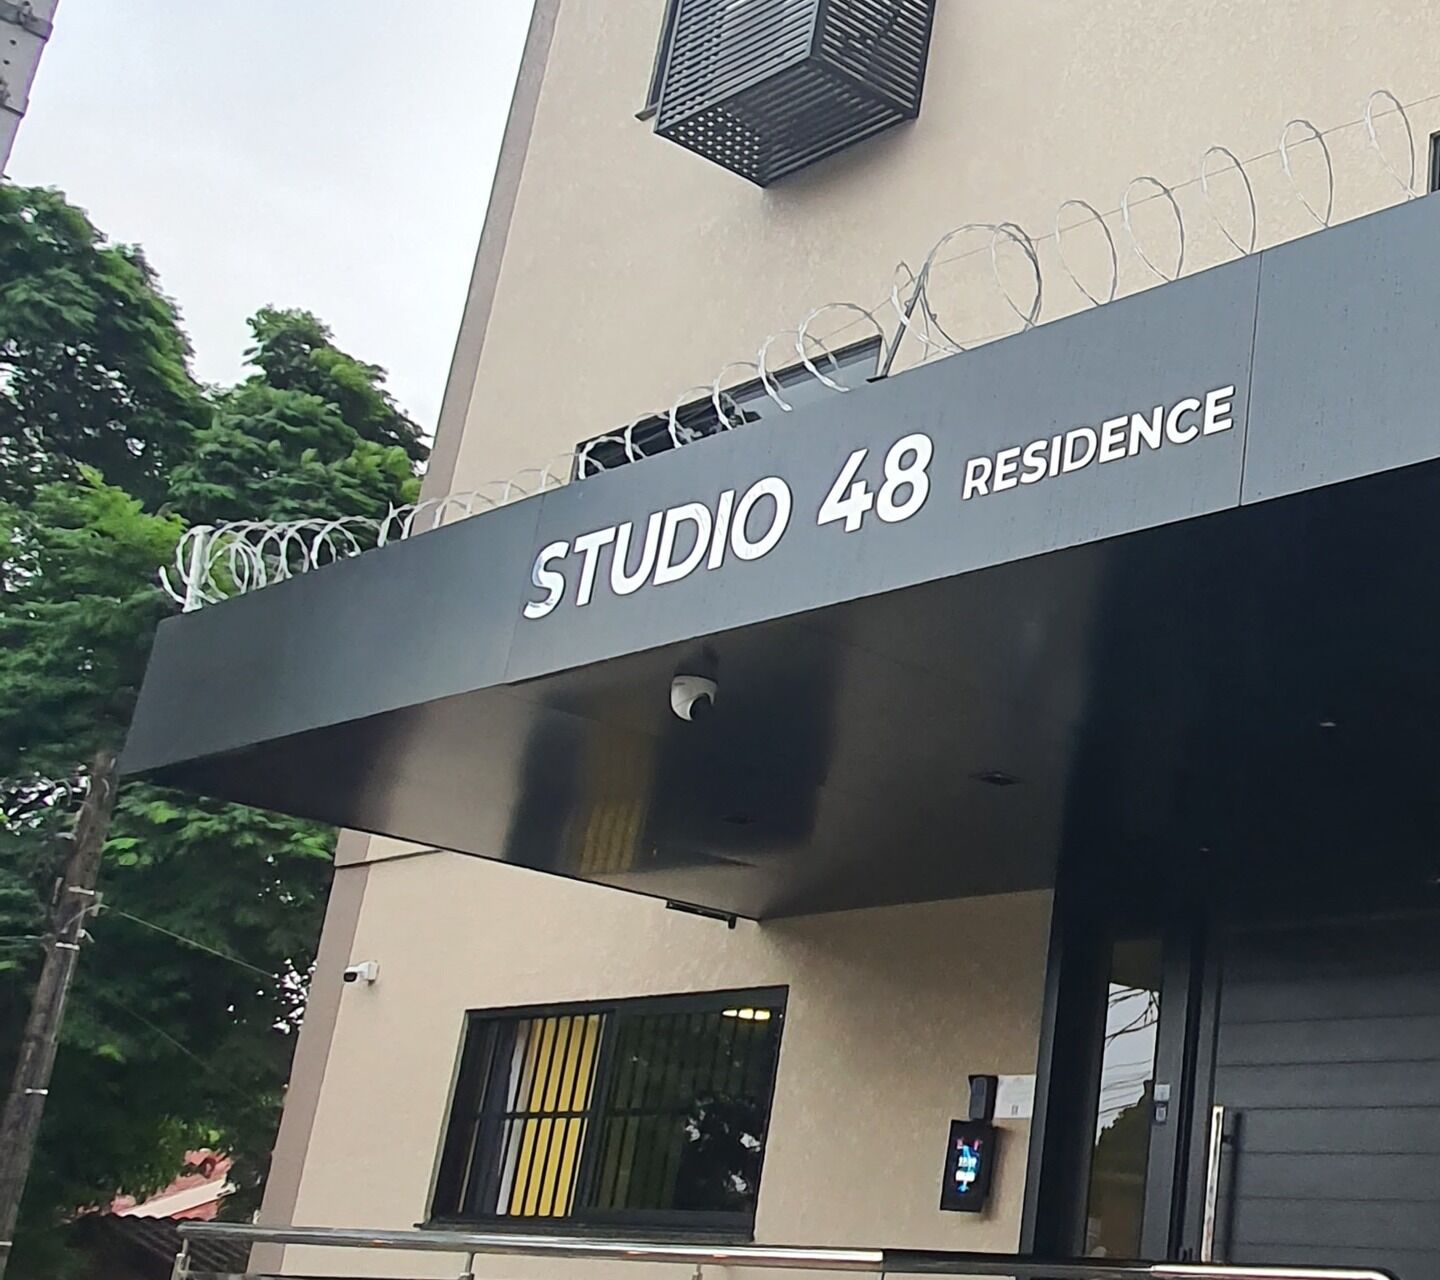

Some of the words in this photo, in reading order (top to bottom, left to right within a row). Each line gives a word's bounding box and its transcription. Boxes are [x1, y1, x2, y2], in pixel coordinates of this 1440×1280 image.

[522, 475, 793, 621] STUDIO
[816, 433, 934, 534] 48
[961, 385, 1235, 500] RESIDENCE
